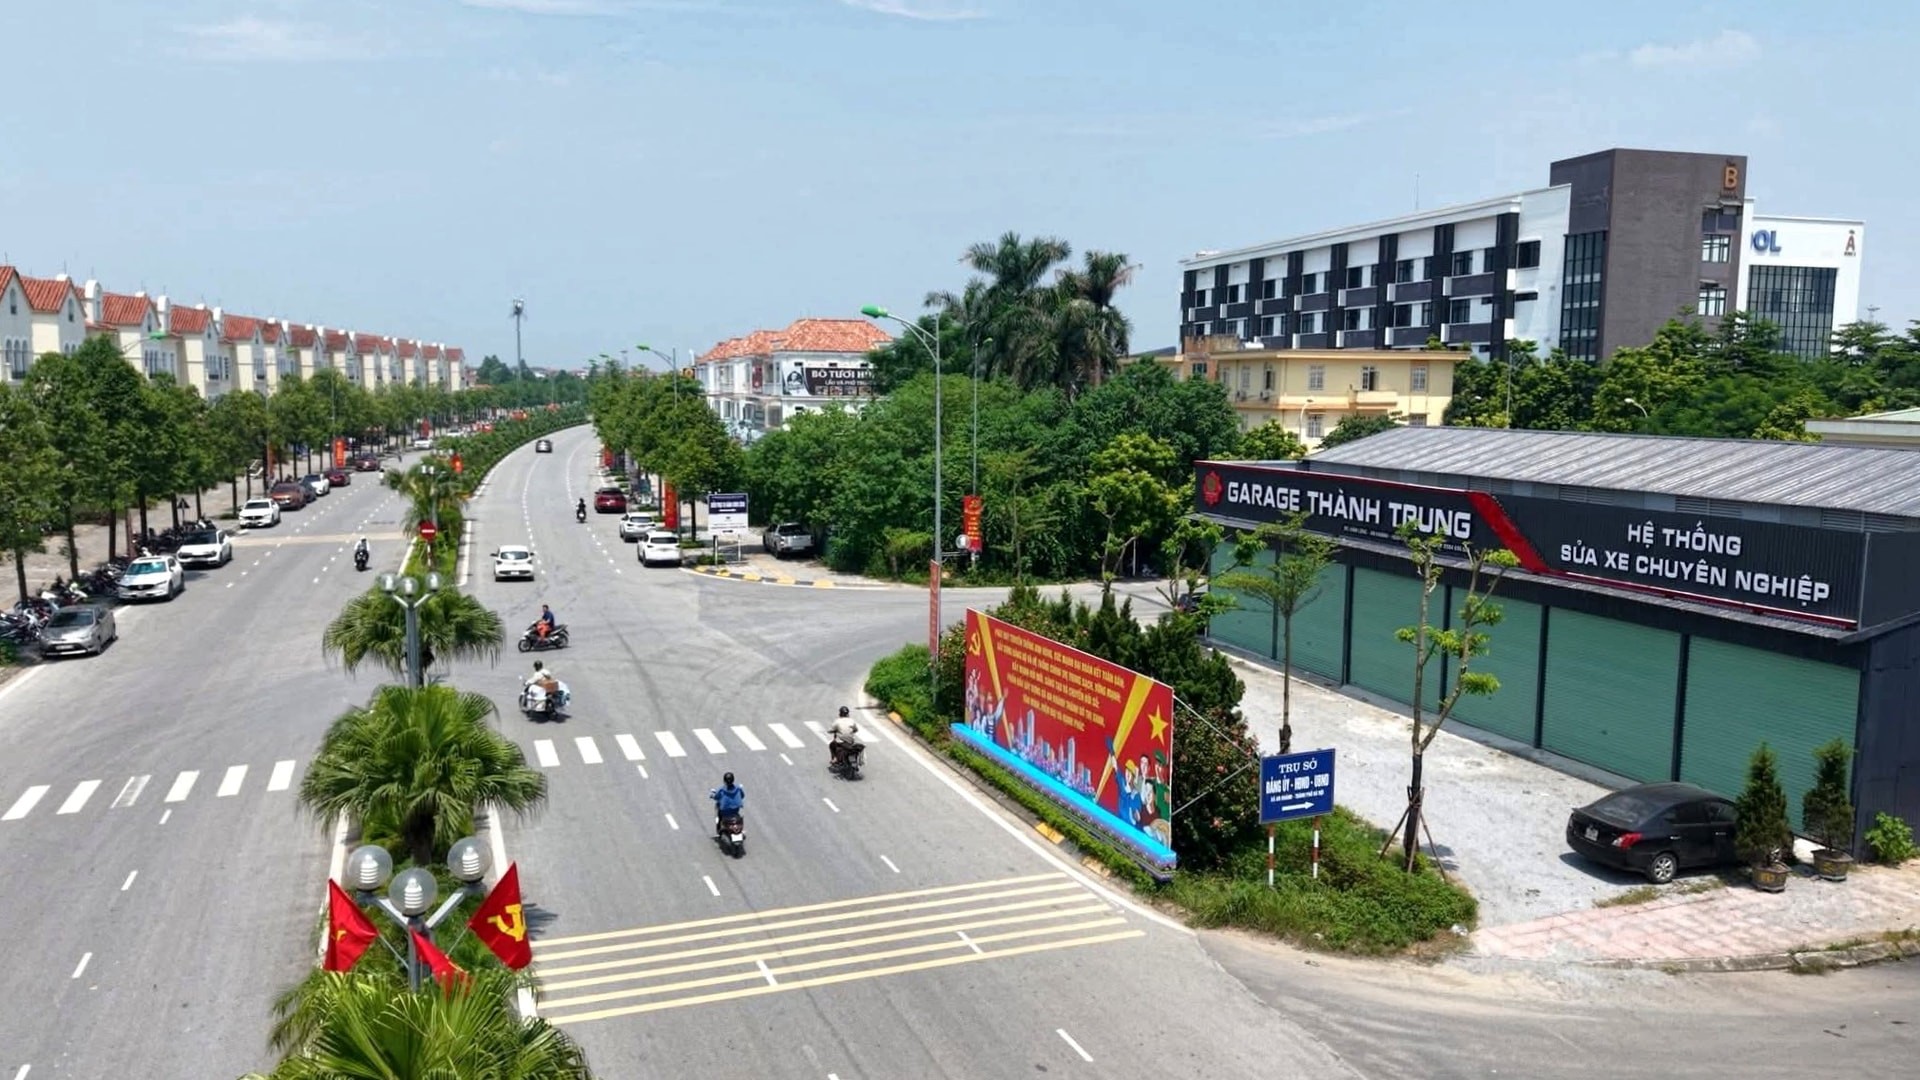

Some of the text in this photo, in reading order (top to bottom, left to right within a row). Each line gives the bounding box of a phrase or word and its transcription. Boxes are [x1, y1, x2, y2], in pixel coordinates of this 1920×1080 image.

[1724, 166, 1738, 188] B
[1751, 229, 1782, 253] OL
[1227, 481, 1301, 512] GARAGE
[1307, 489, 1380, 525] THÀNH
[1388, 502, 1472, 540] TRUNG
[1628, 520, 1742, 557] HỆ THỐNG
[1560, 539, 1830, 606] SỬA XE CHUYÊN NGHIỆP
[1278, 758, 1317, 774] TRỤ SỞ
